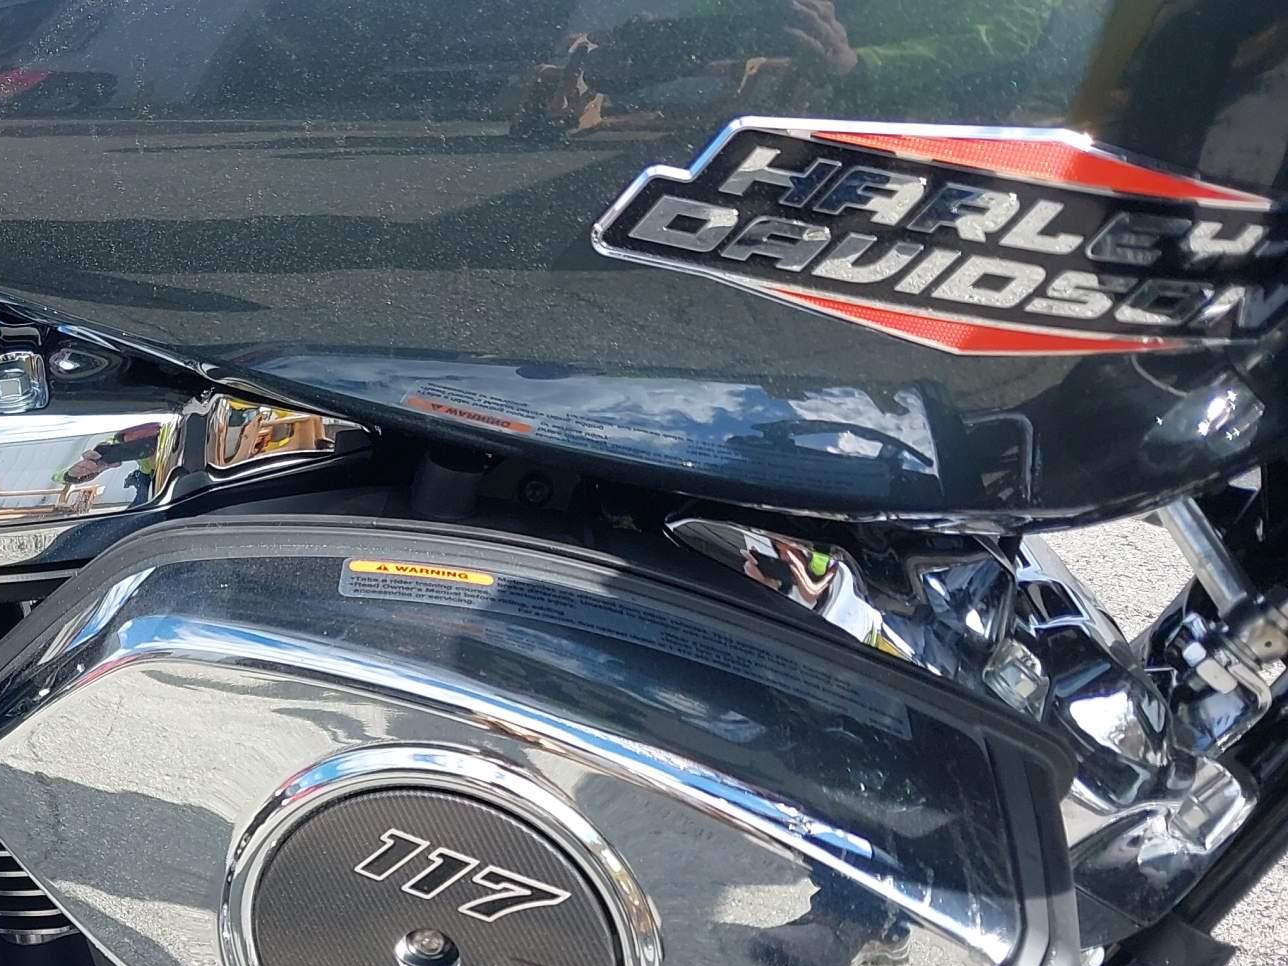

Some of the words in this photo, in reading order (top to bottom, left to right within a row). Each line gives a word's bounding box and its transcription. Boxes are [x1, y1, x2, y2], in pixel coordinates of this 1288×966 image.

[627, 195, 1288, 328] DAVIDSON
[395, 565, 469, 580] WARNING
[354, 827, 572, 922] 117
